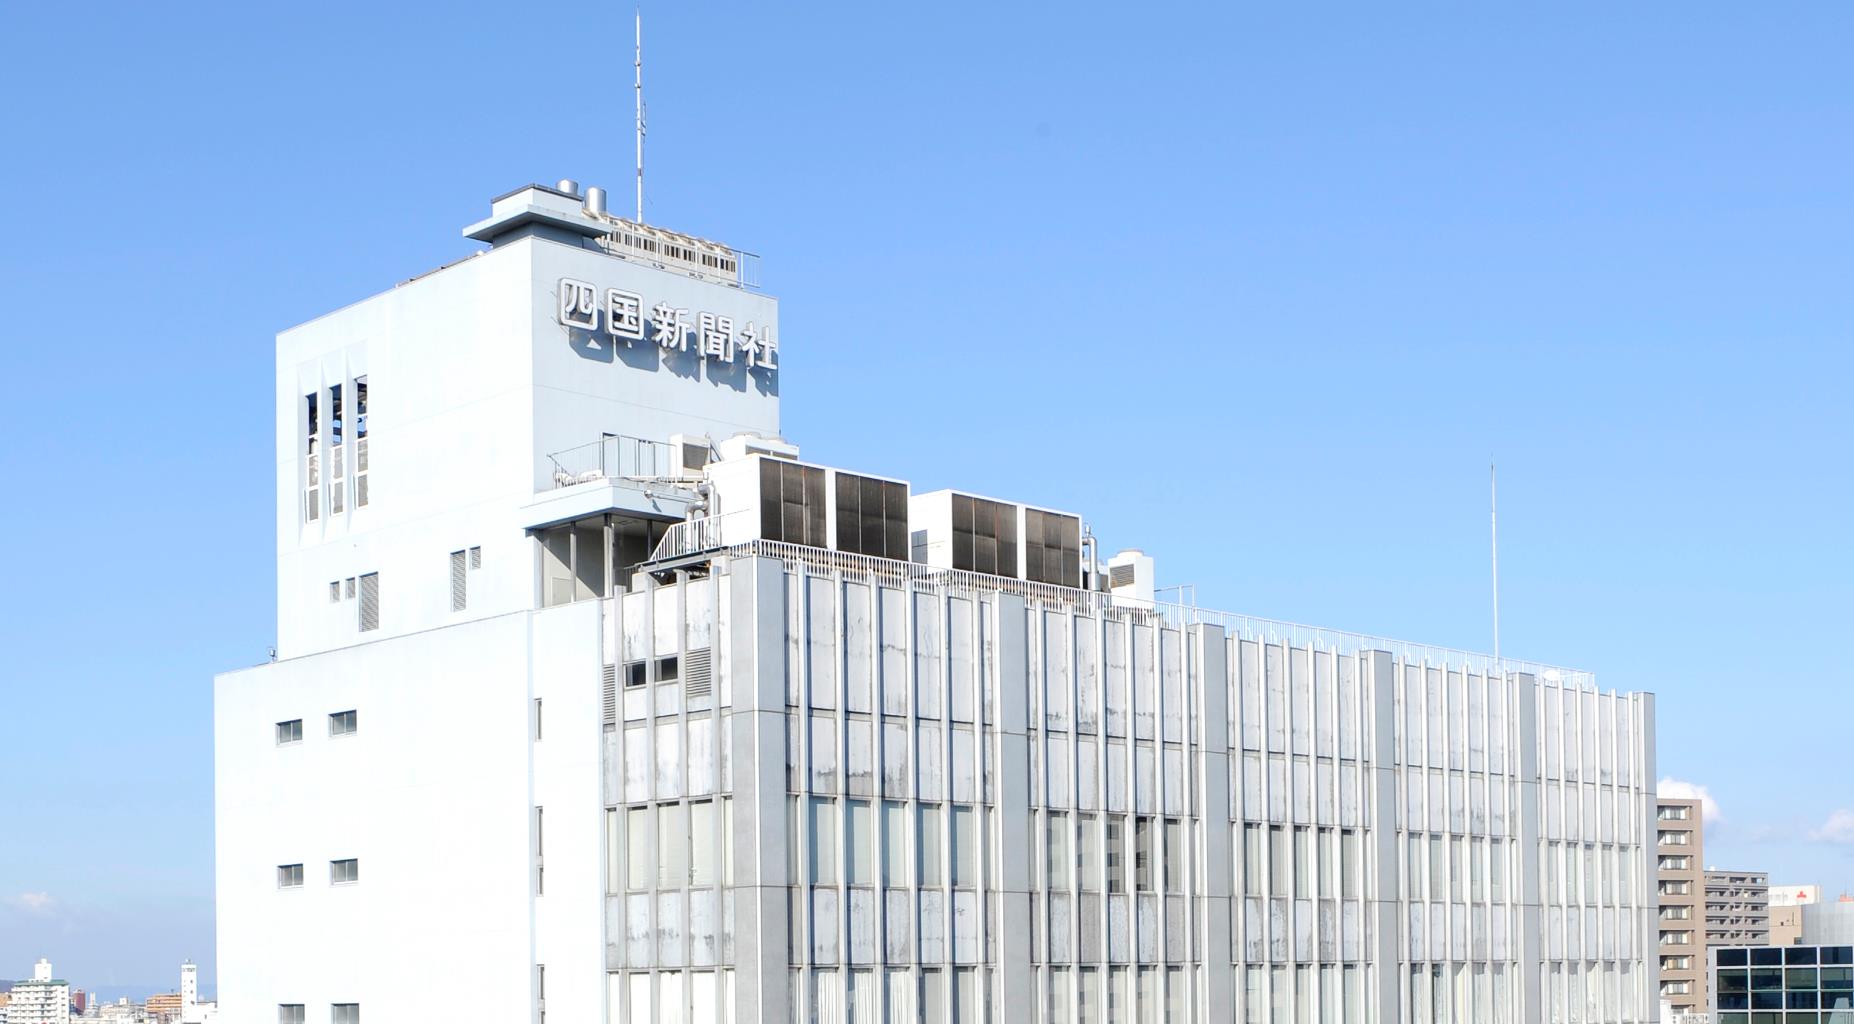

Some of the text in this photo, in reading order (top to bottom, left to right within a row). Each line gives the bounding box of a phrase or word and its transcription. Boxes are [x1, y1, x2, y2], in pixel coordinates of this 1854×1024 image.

[557, 277, 777, 369] 四国新聞社
